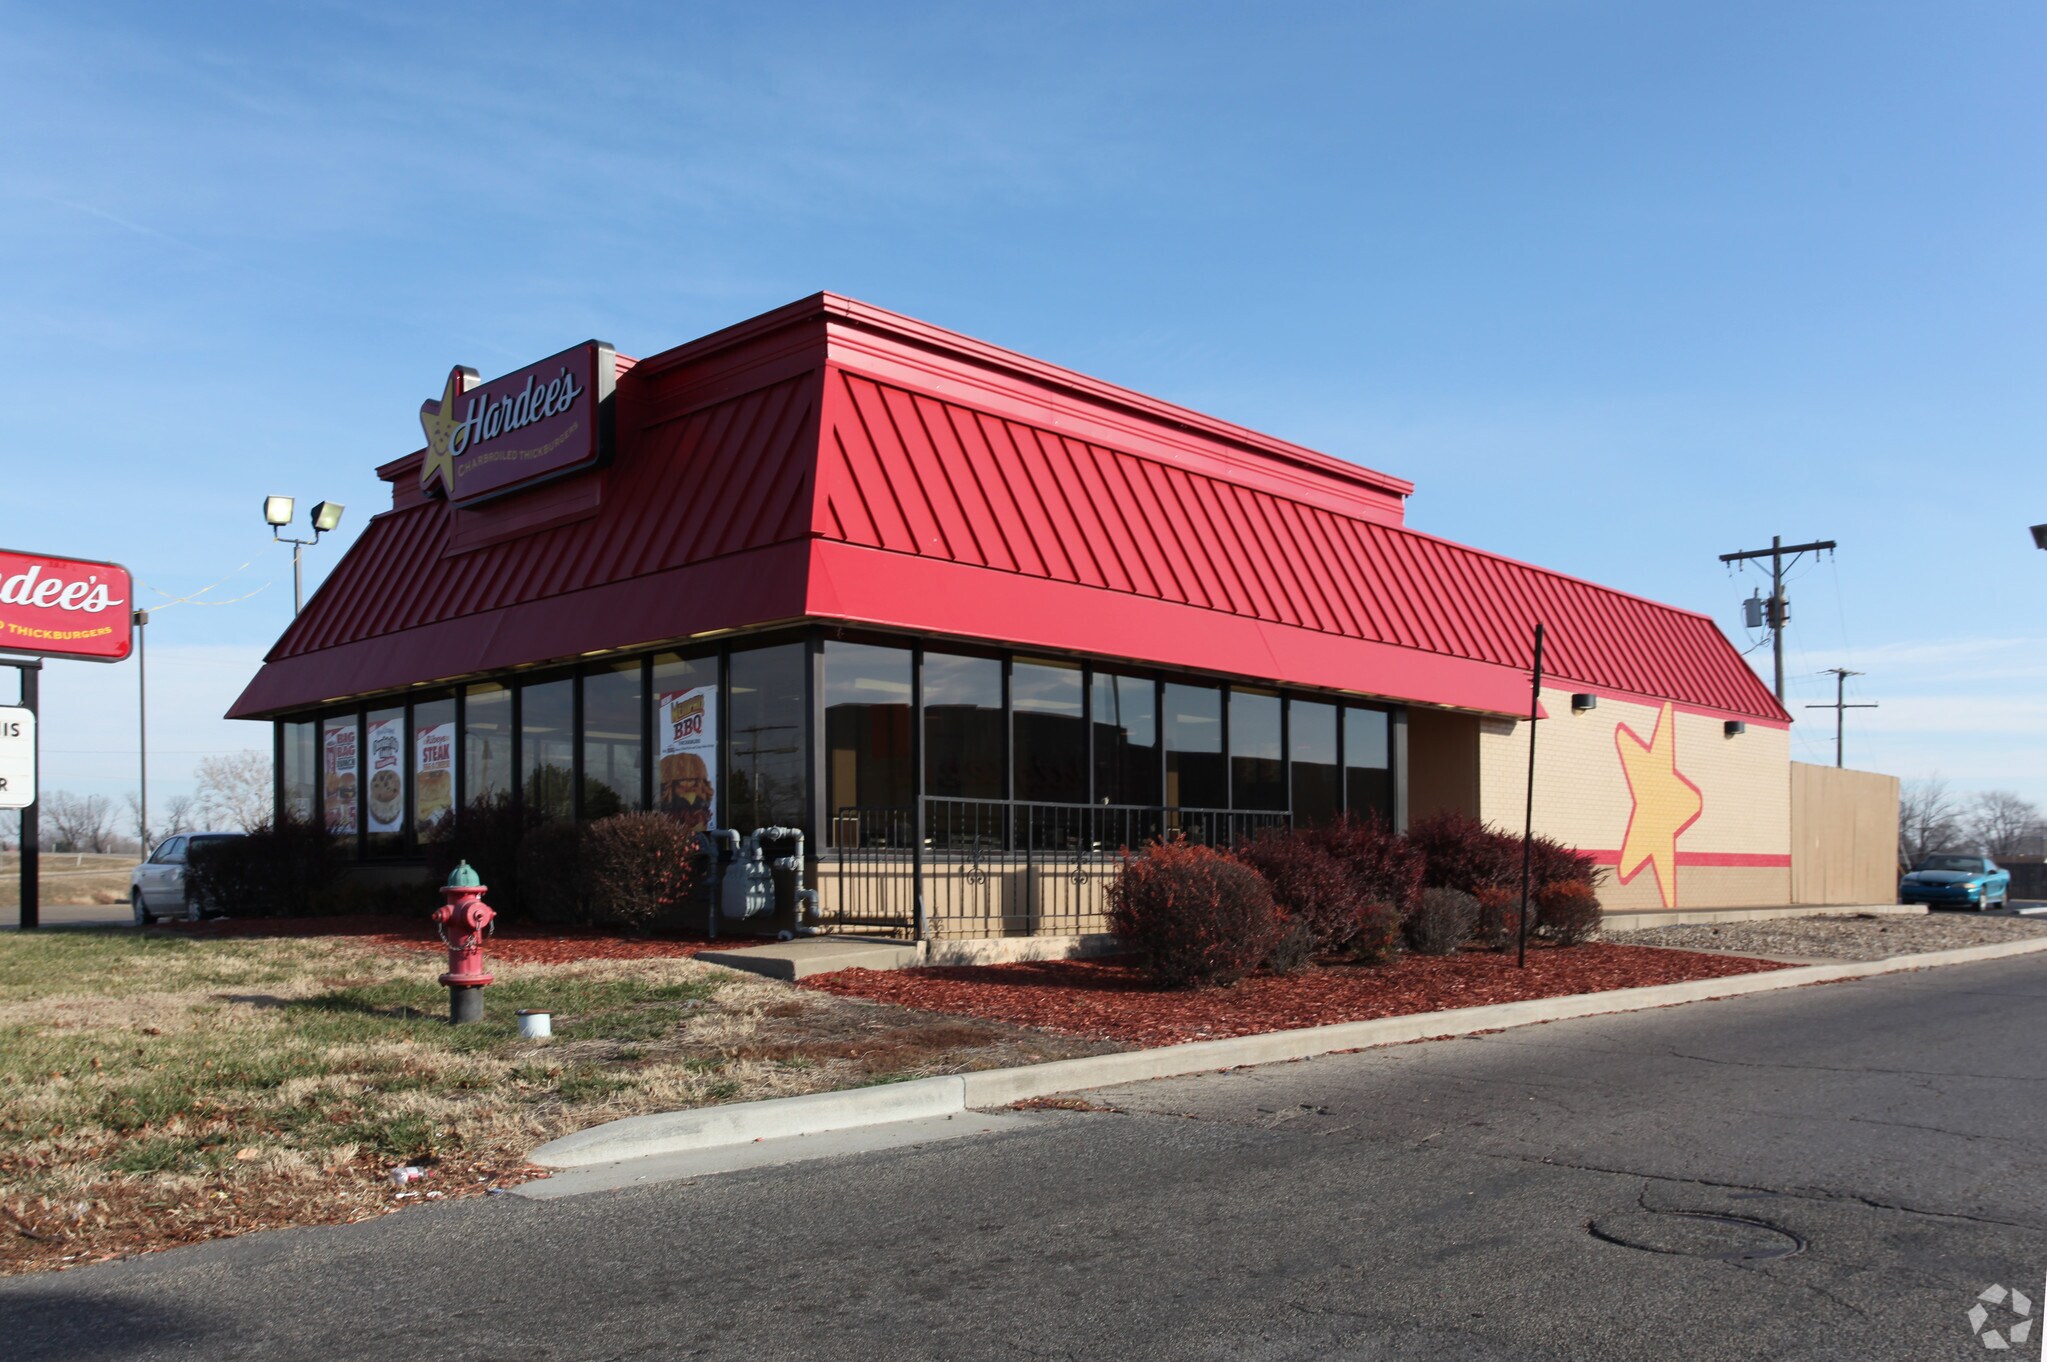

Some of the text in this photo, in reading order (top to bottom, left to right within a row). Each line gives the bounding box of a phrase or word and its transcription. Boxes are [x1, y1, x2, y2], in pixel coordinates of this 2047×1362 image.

[450, 367, 583, 457] Hardee's
[0, 565, 124, 613] dee's
[8, 623, 113, 640] THICKBURGERS
[0, 722, 20, 737] IS
[673, 714, 702, 741] BBQ
[423, 744, 450, 763] STEAK
